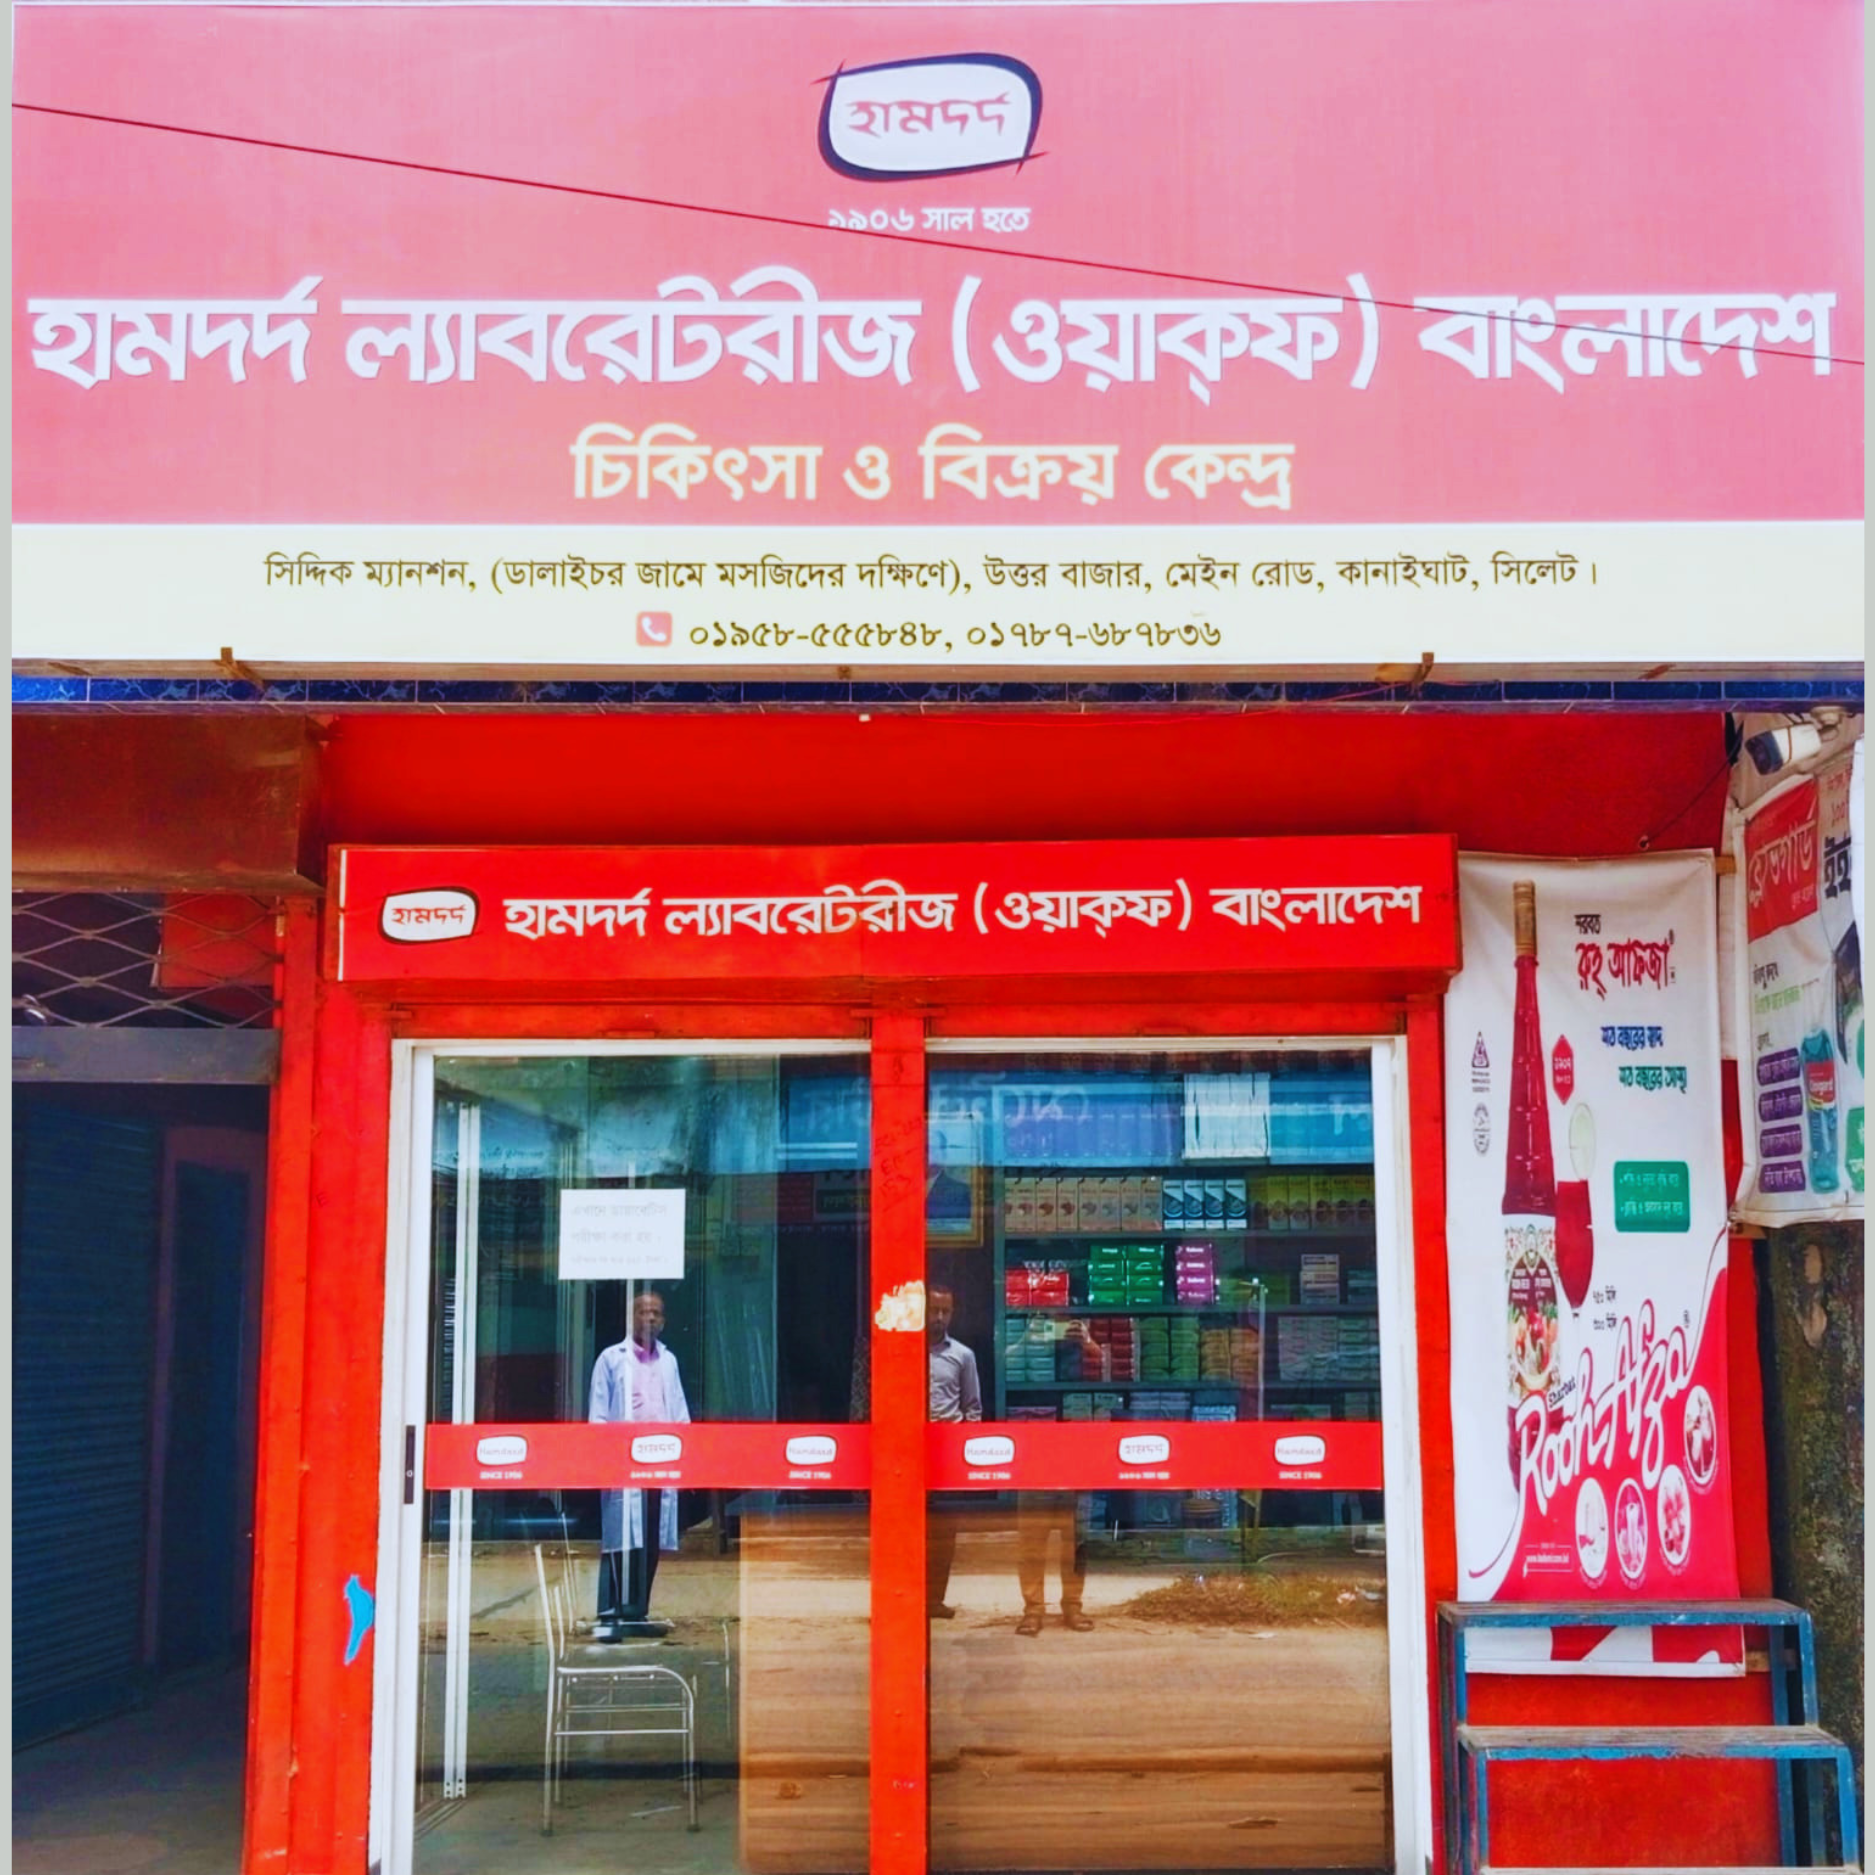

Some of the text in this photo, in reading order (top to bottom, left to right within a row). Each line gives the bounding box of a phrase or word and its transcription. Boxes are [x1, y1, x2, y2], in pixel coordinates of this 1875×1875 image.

[847, 91, 1012, 138] হামদর্দ
[828, 208, 1032, 234] ১৯০৬ সাল হতে
[28, 276, 324, 390] হামদর্দ
[342, 266, 923, 387] ল্যাবরেটরীজ
[1414, 292, 1838, 396] বাংলাদেশ
[570, 422, 1297, 512] চিকিৎসা ও বিক্রয় কেন্দ্র
[264, 551, 355, 588] সিদ্দিক
[363, 558, 477, 592] ম্যানশন,
[491, 553, 627, 596] (ডালাইচর
[635, 560, 708, 589] জামে
[716, 553, 848, 590] মসজিদের
[856, 553, 973, 596] দক্ষিণে),
[983, 554, 1051, 589] উত্তর
[1059, 560, 1153, 594] বাজার,
[1166, 553, 1241, 591] মেইন
[1252, 561, 1326, 593] রোড,
[1336, 552, 1480, 592] কানাইঘাট,
[1490, 550, 1580, 586] সিলেট
[690, 621, 1223, 653] ০১৯৫৮-৫৫৫৮৪৮, ০১৭৮৭-৬৮৭৮৩৬
[391, 904, 466, 925] হামদর্দ
[503, 888, 653, 941] হামদর্দ
[663, 878, 960, 938] ল্যাবরেটরীজ
[1210, 885, 1424, 932] বাংলাদেশ
